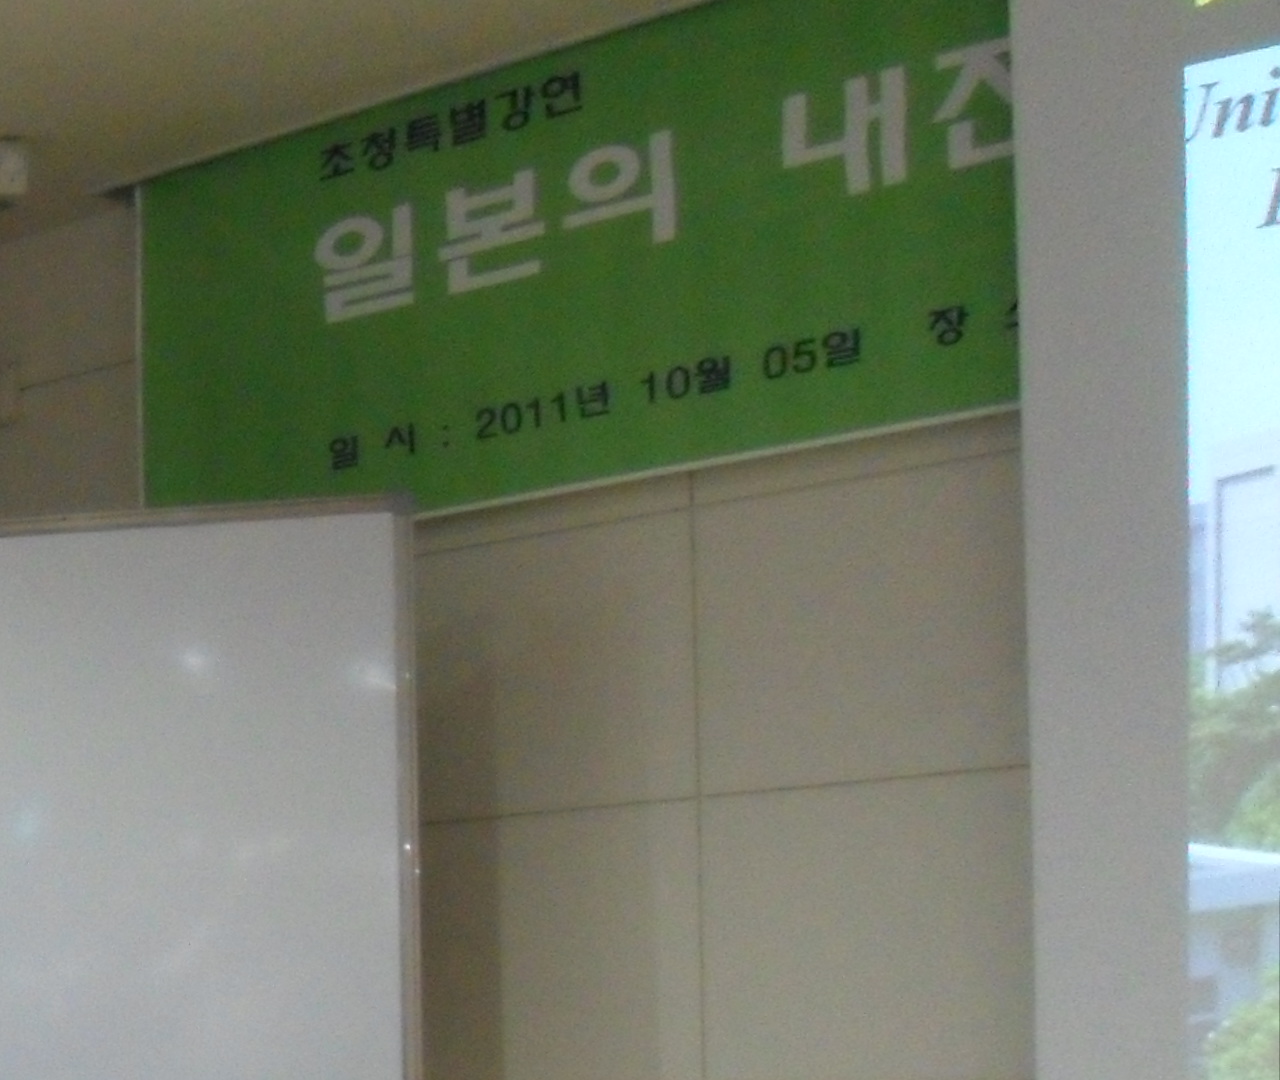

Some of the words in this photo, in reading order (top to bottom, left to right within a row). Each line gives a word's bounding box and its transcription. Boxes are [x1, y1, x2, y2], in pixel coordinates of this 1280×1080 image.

[319, 71, 583, 181] 초청특별강연
[314, 129, 676, 324] 일본의
[475, 380, 611, 440] 2011년
[640, 355, 731, 402] 10월
[762, 328, 861, 380] 05일
